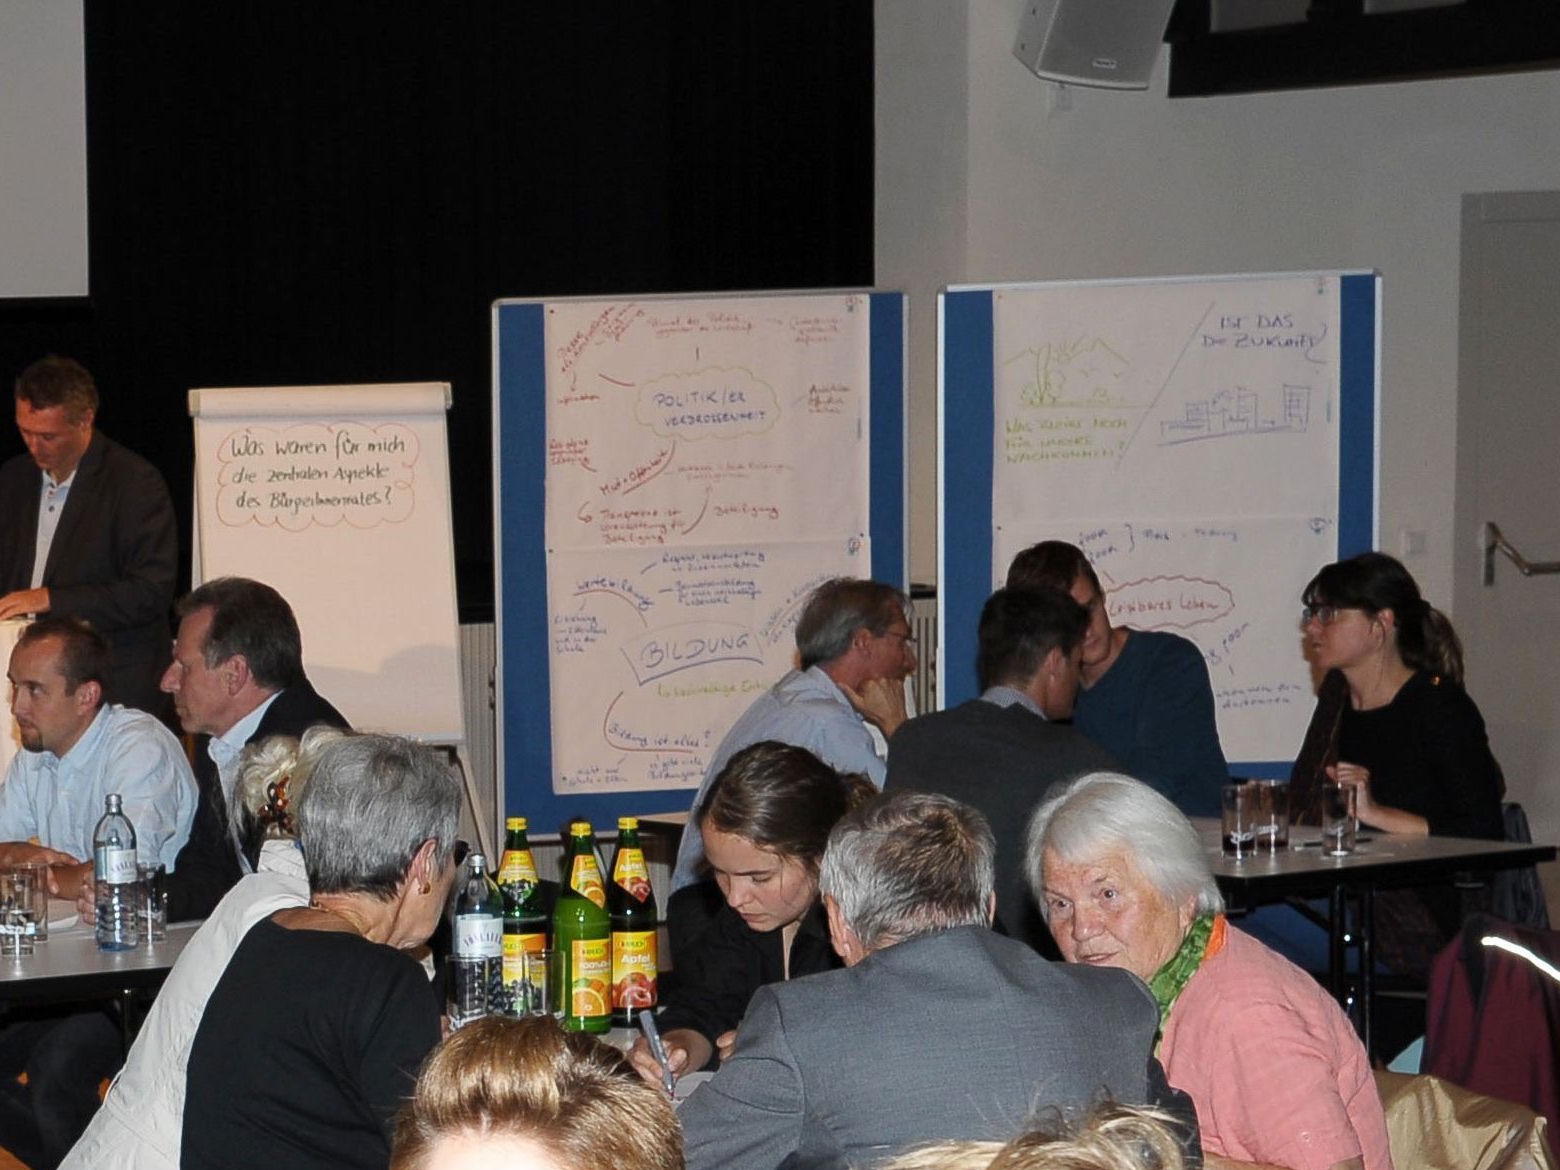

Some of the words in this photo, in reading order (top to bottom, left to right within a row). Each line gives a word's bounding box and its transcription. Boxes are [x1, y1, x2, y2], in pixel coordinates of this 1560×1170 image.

[1257, 314, 1293, 328] DAS
[230, 431, 265, 457] Was
[274, 436, 328, 455] waren
[335, 430, 361, 460] für
[367, 435, 406, 454] mich
[231, 467, 257, 484] die
[266, 465, 329, 482] zentralen
[640, 632, 750, 669] BILDUNG
